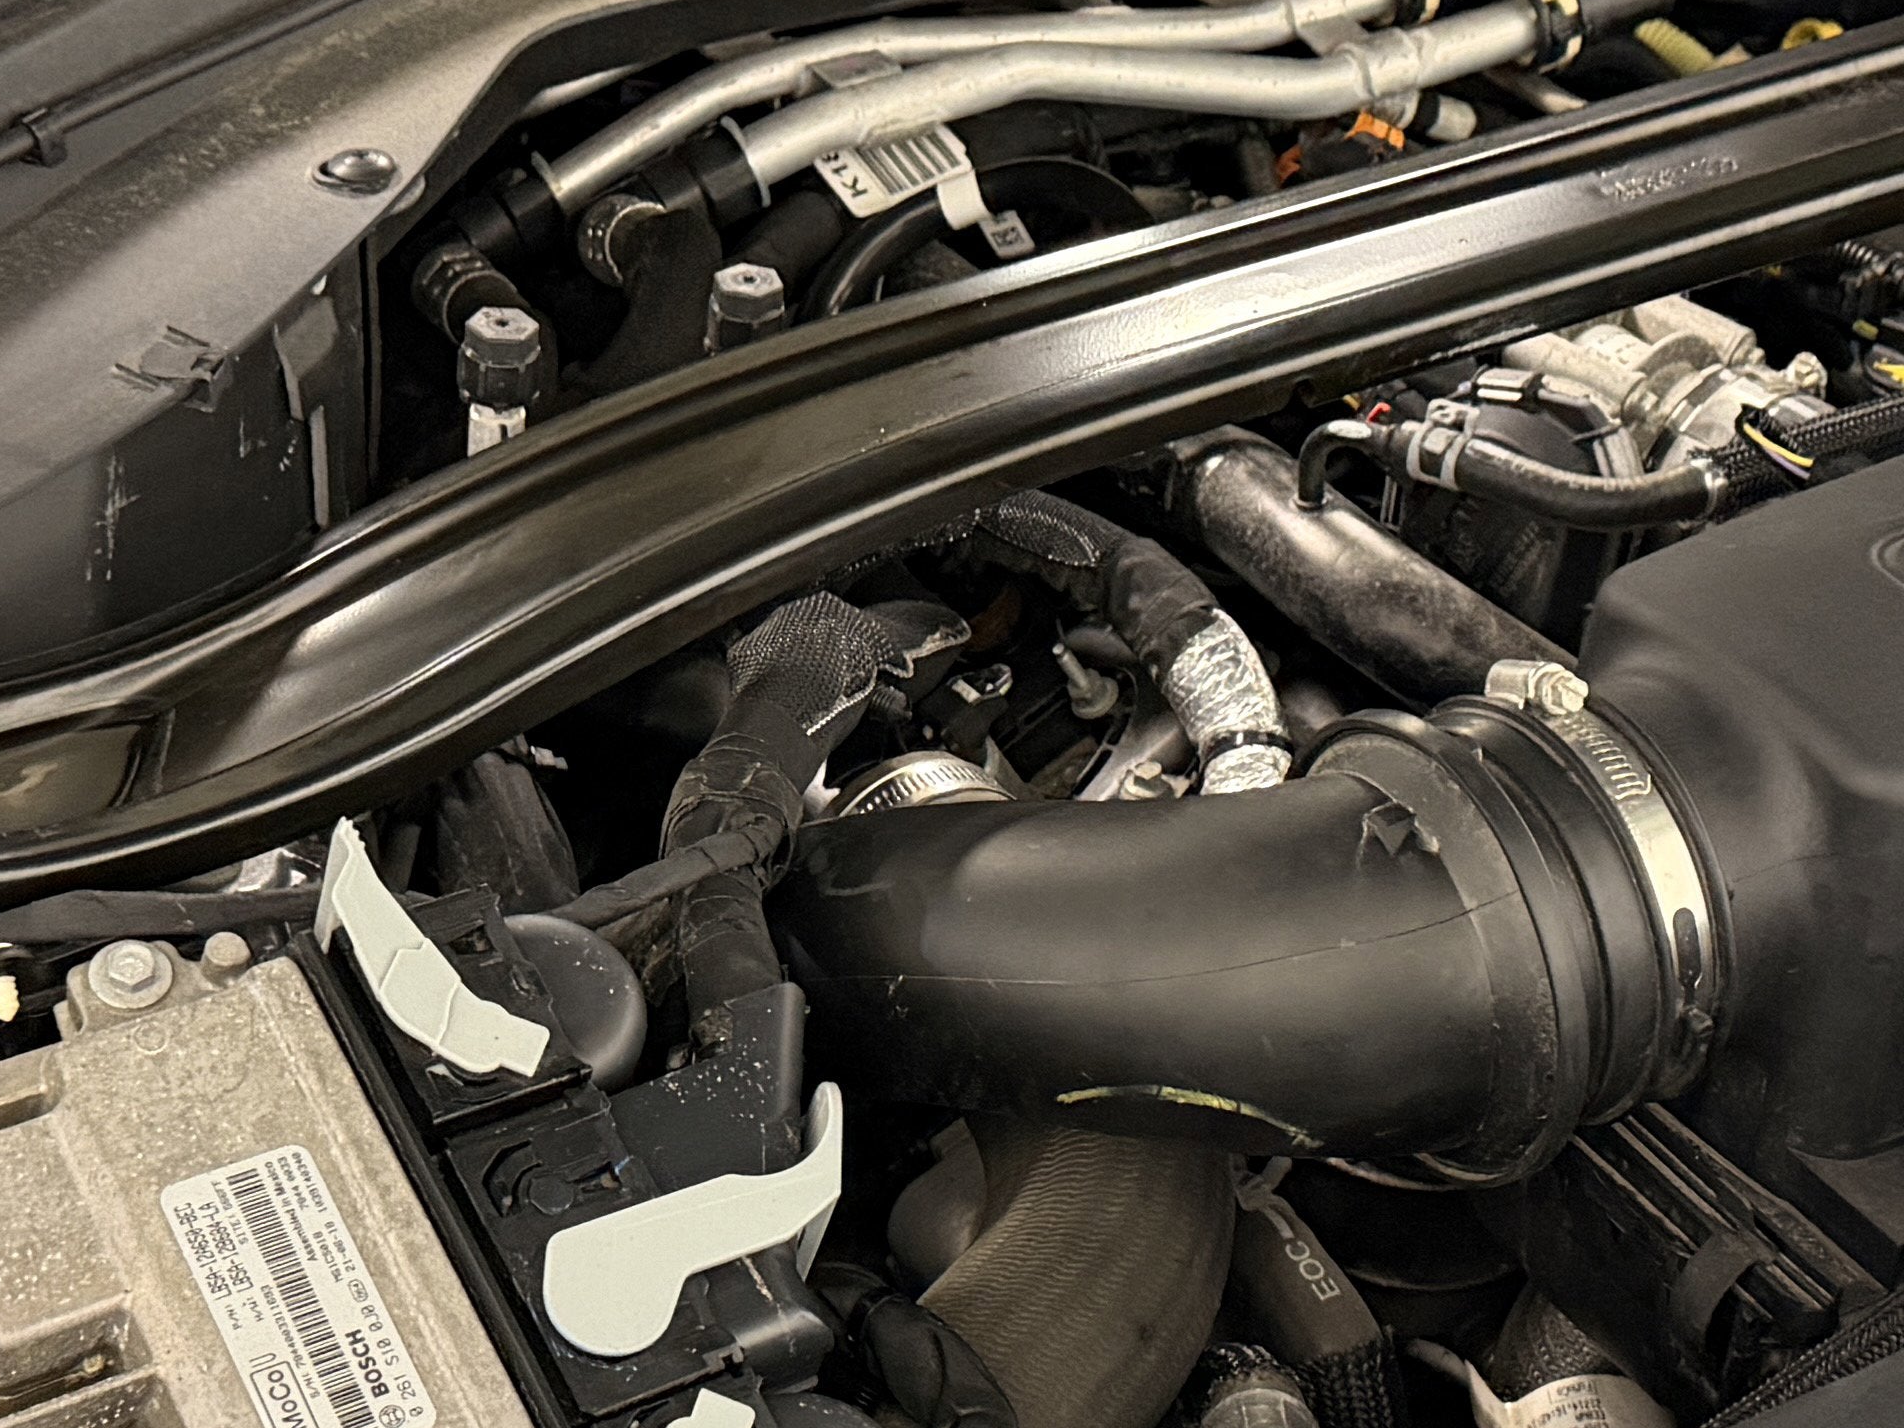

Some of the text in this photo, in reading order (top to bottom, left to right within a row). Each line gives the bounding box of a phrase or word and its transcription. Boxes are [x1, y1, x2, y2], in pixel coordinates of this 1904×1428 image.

[265, 1161, 286, 1196] Mexico
[284, 1208, 318, 1261] Assembled
[1284, 1238, 1342, 1303] EOC
[345, 1329, 390, 1398] BOSCH
[393, 1374, 416, 1400] 261
